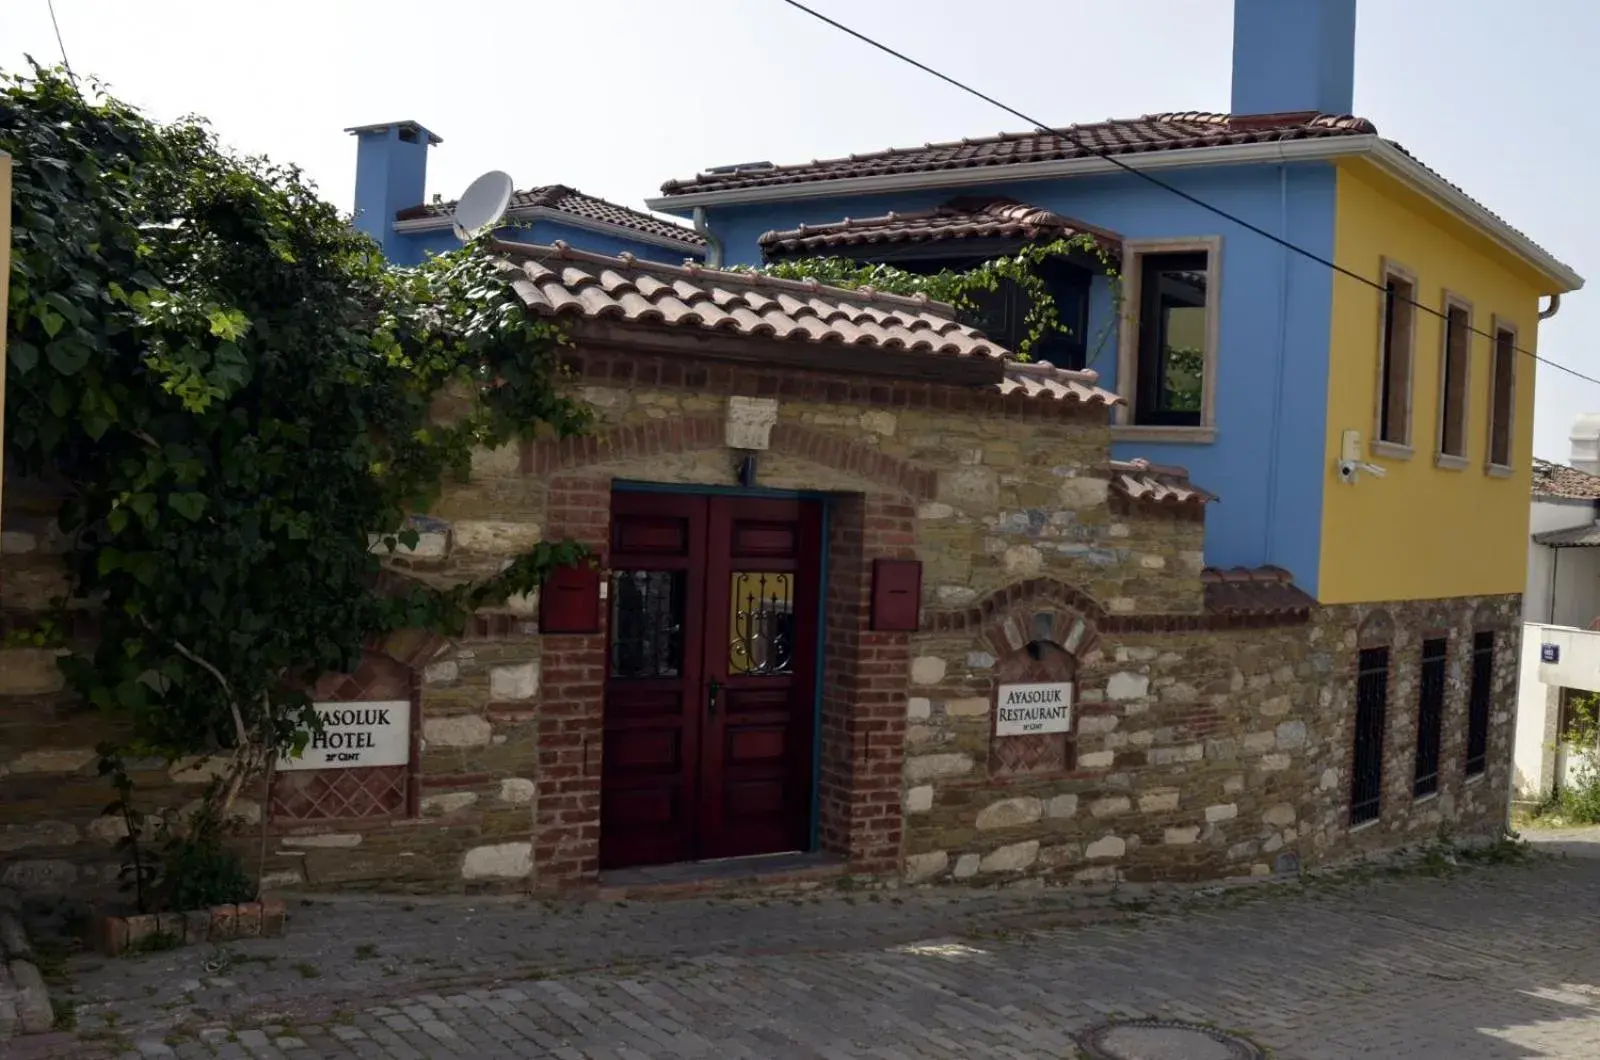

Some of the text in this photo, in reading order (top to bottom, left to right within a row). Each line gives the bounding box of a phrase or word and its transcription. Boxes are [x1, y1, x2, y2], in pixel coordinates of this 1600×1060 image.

[1007, 690, 1062, 704] AYASOLUK
[294, 709, 391, 726] ASOLUK
[999, 706, 1068, 721] RESTAURANT
[311, 731, 375, 749] HOTEL
